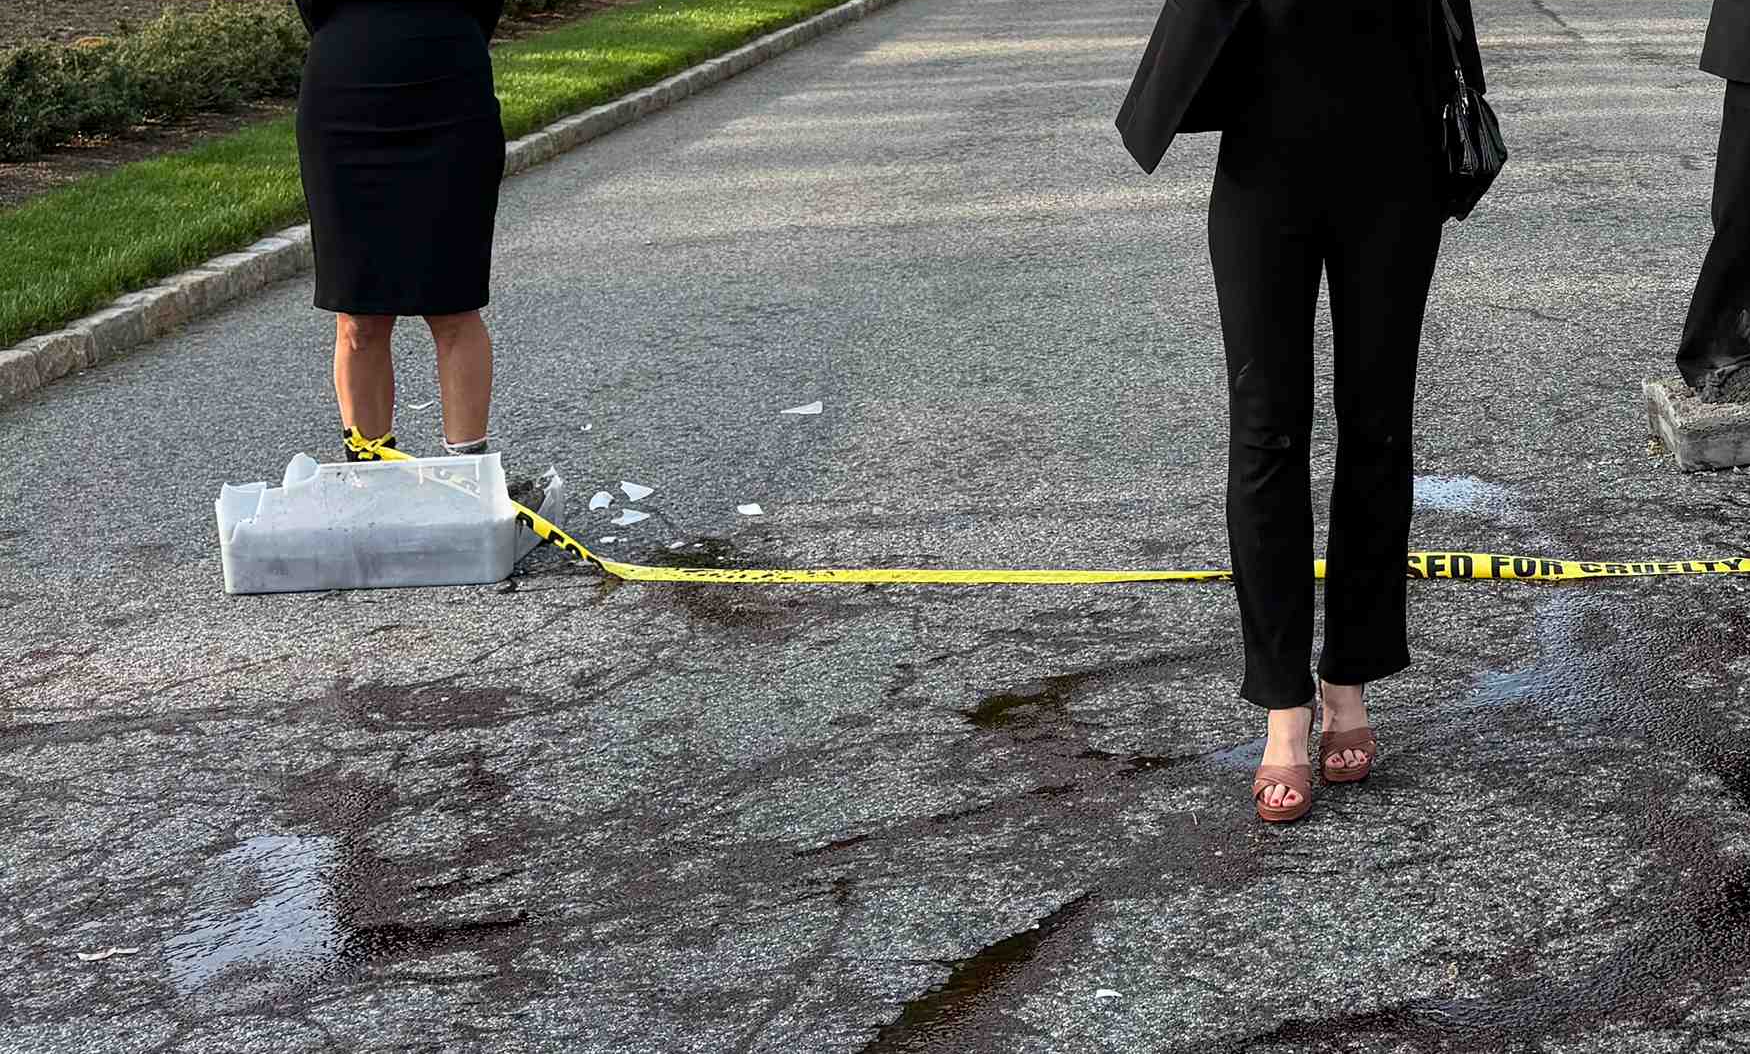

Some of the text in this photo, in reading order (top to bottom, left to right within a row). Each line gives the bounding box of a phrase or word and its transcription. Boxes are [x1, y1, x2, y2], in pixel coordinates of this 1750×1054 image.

[1407, 554, 1744, 579] SED FOR CRUELTY
